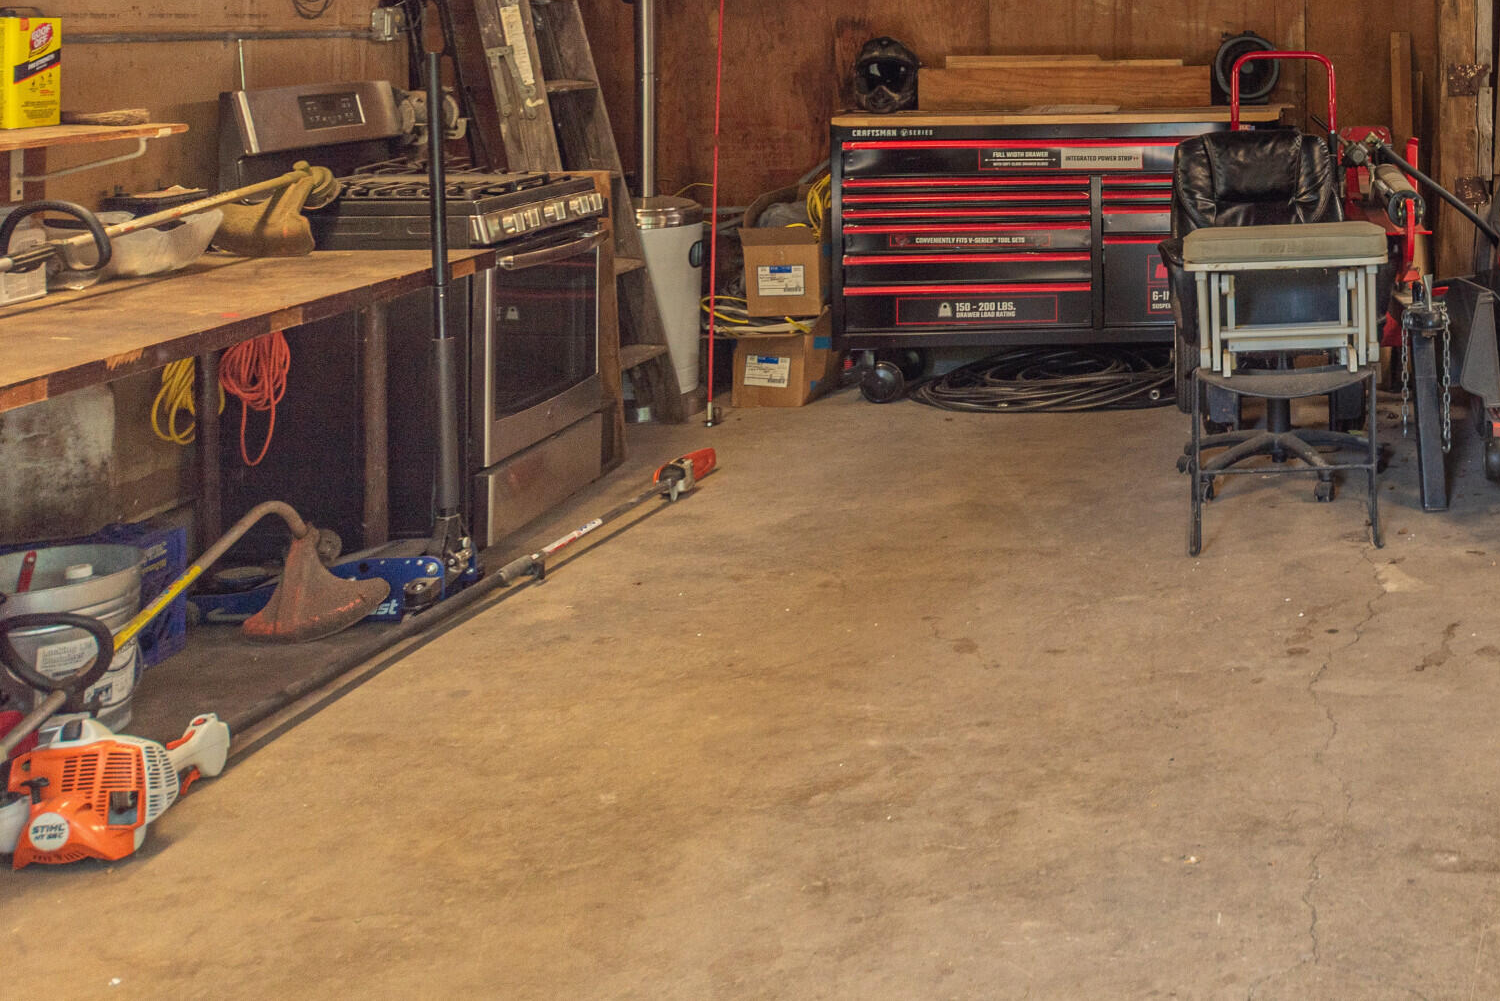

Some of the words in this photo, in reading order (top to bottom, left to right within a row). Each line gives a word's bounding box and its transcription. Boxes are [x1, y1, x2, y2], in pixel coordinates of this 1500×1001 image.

[955, 302, 970, 312] 150
[978, 302, 995, 312] 200
[997, 302, 1016, 311] LBS.
[32, 823, 65, 834] STIHL
